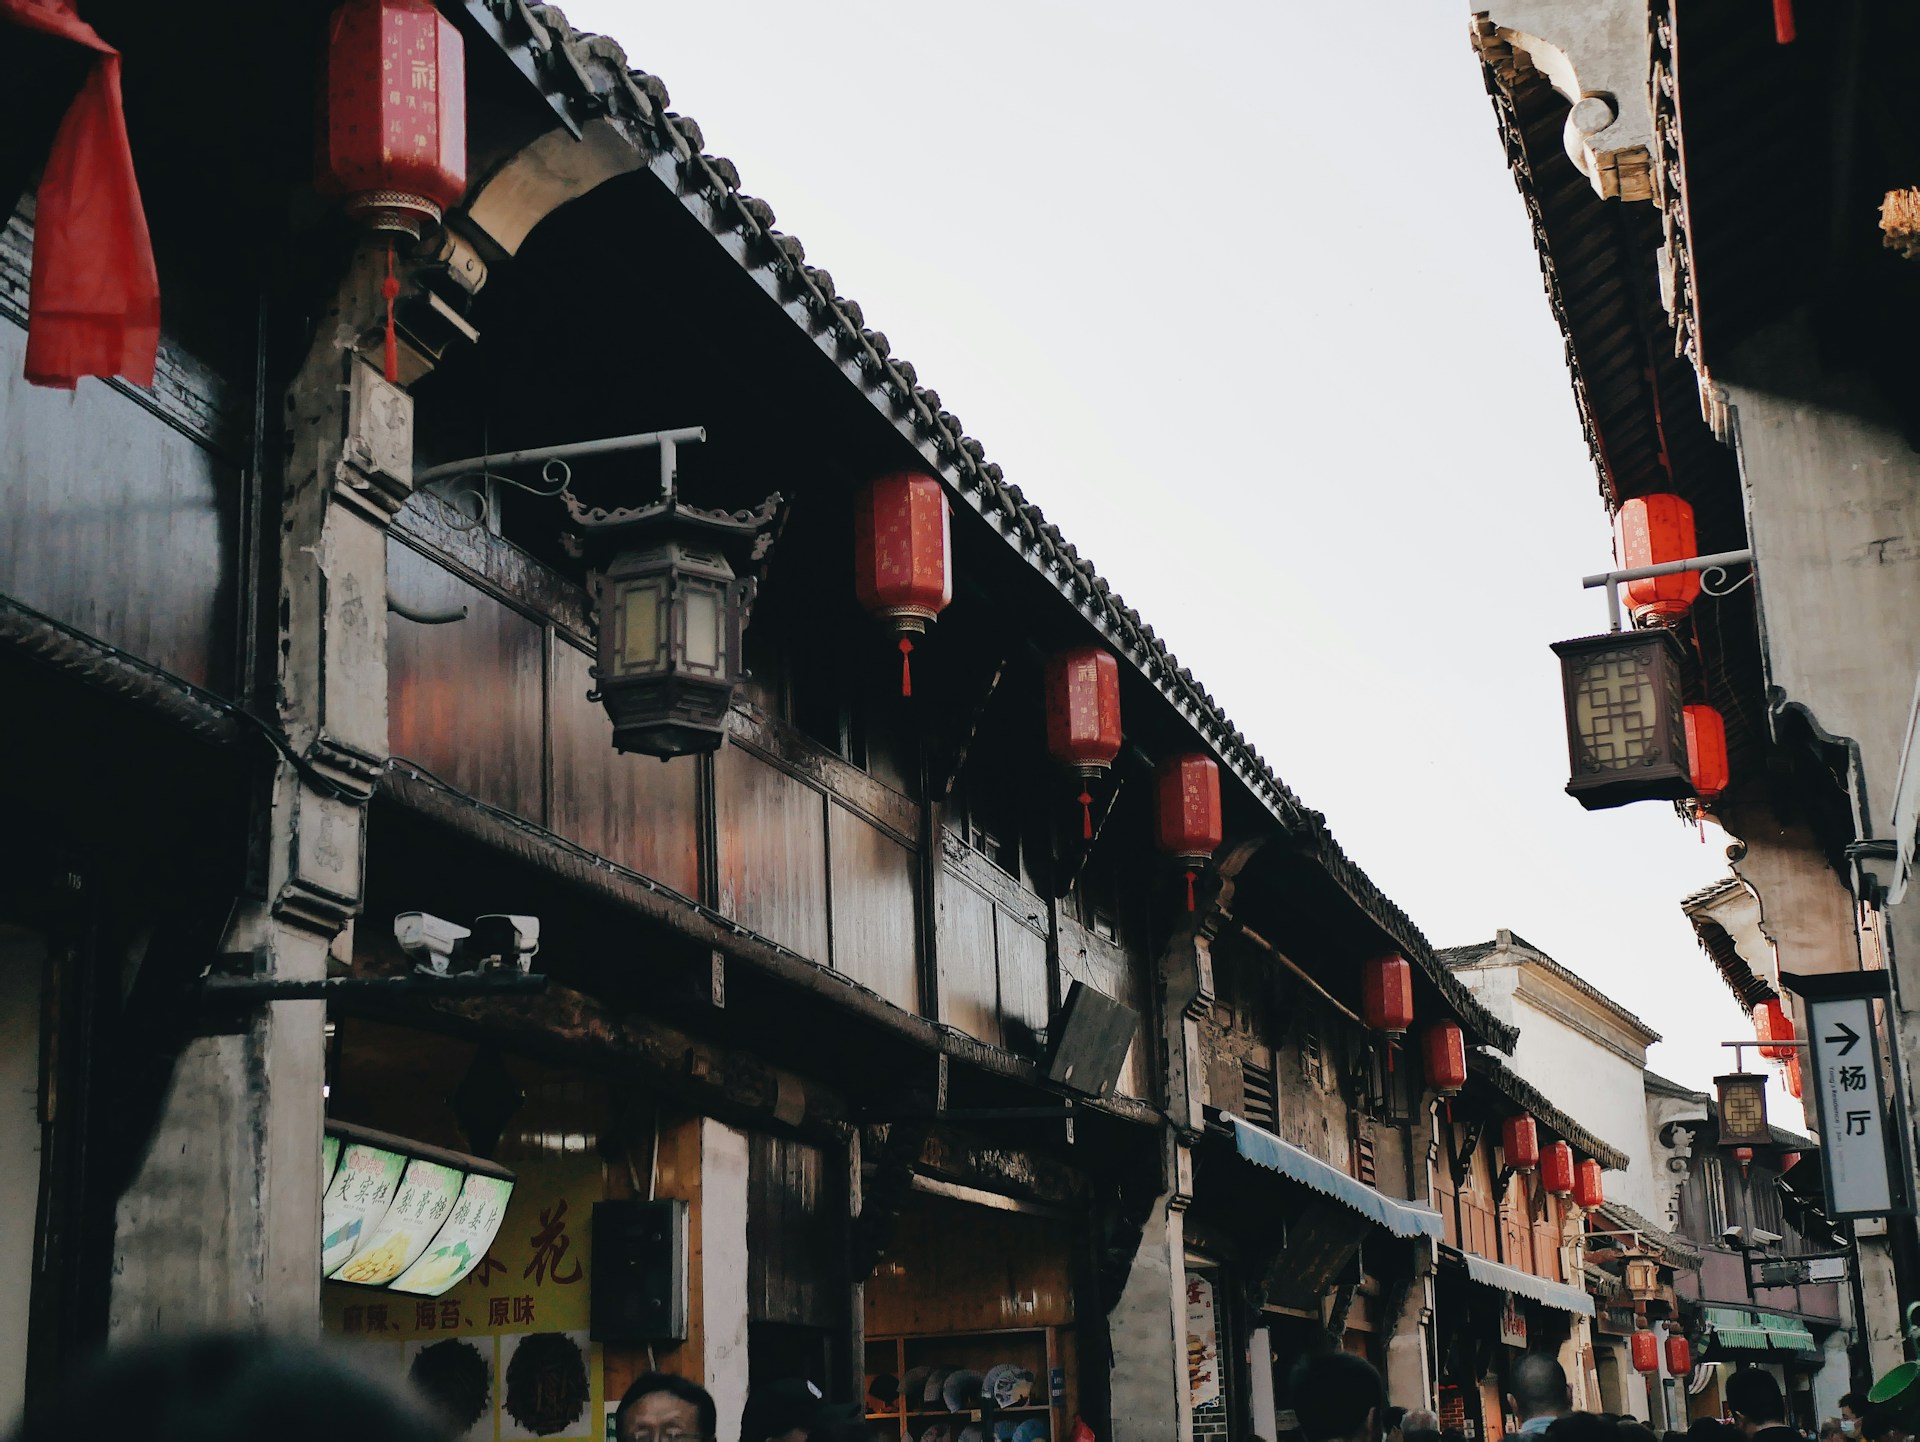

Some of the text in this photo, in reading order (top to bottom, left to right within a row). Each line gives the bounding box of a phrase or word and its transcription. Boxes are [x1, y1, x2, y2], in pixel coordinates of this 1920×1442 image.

[1839, 1066, 1871, 1136] 杨厅
[397, 1187, 448, 1220] 梨膏糖
